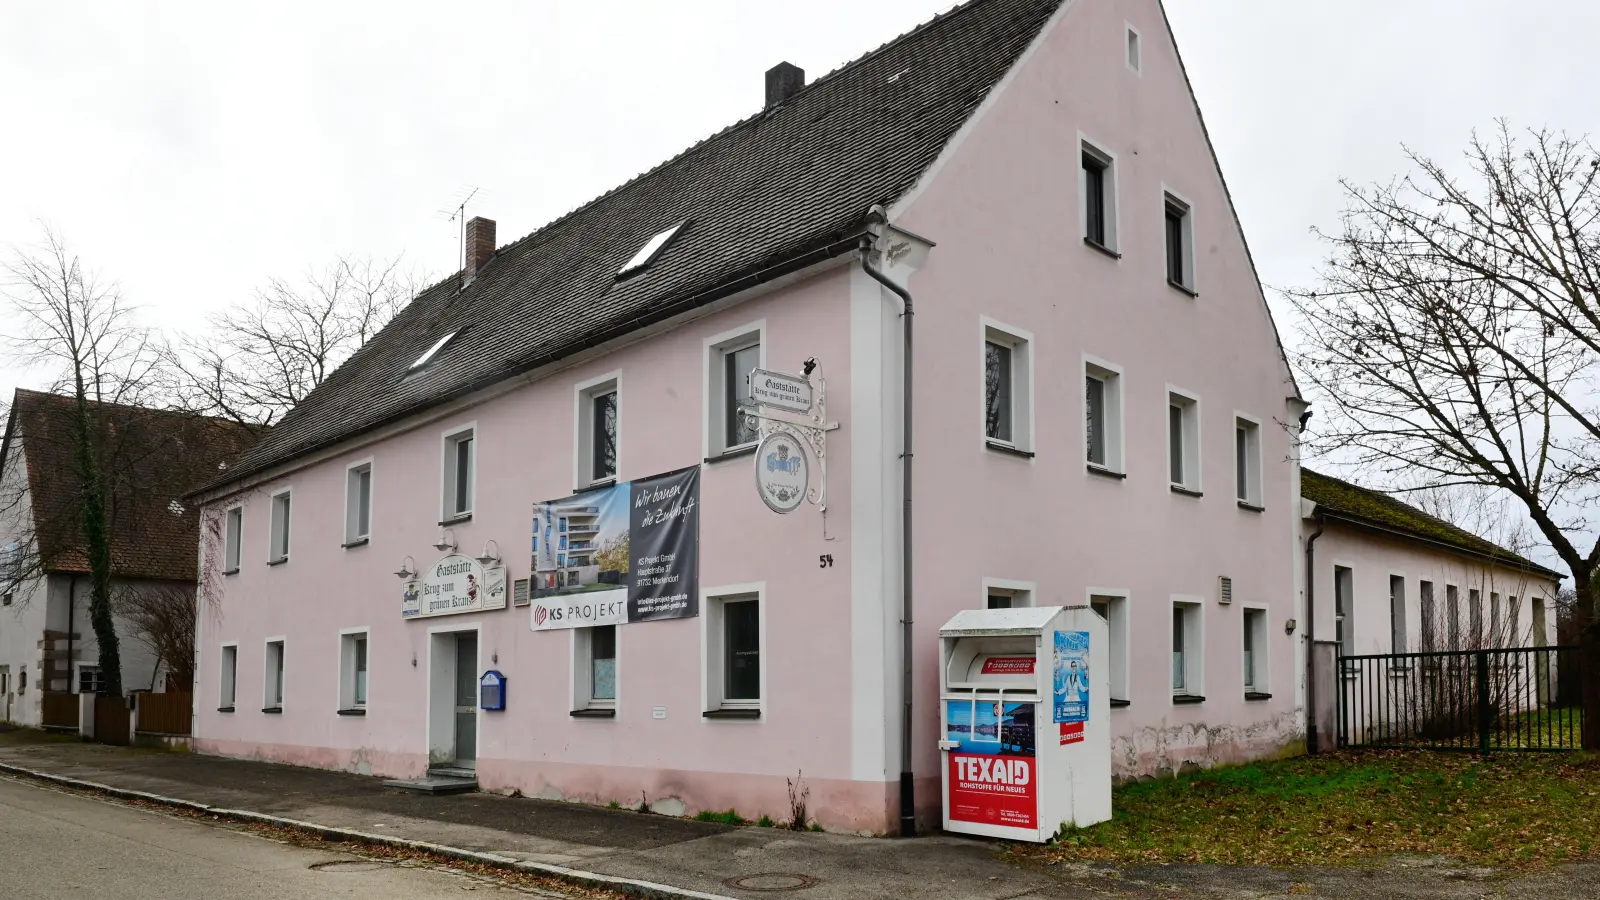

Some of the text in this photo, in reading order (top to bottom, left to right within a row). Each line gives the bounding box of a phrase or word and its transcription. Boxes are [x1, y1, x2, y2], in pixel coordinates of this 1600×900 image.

[766, 378, 800, 394] Gaststätte
[635, 484, 680, 508] Wir bauen
[642, 496, 695, 528] die Zukunft
[638, 552, 676, 566] KS Projekt GmbH
[820, 554, 834, 568] 54
[436, 560, 472, 577] Gaststätte
[637, 566, 665, 576] Hauptstraße
[652, 574, 679, 585] Merkendorf
[424, 582, 454, 596] Krug zum
[430, 597, 450, 612] grünen
[550, 602, 623, 620] KS PROJEKT
[955, 756, 1030, 786] TEXAID
[960, 782, 992, 791] ROHSTOFFE
